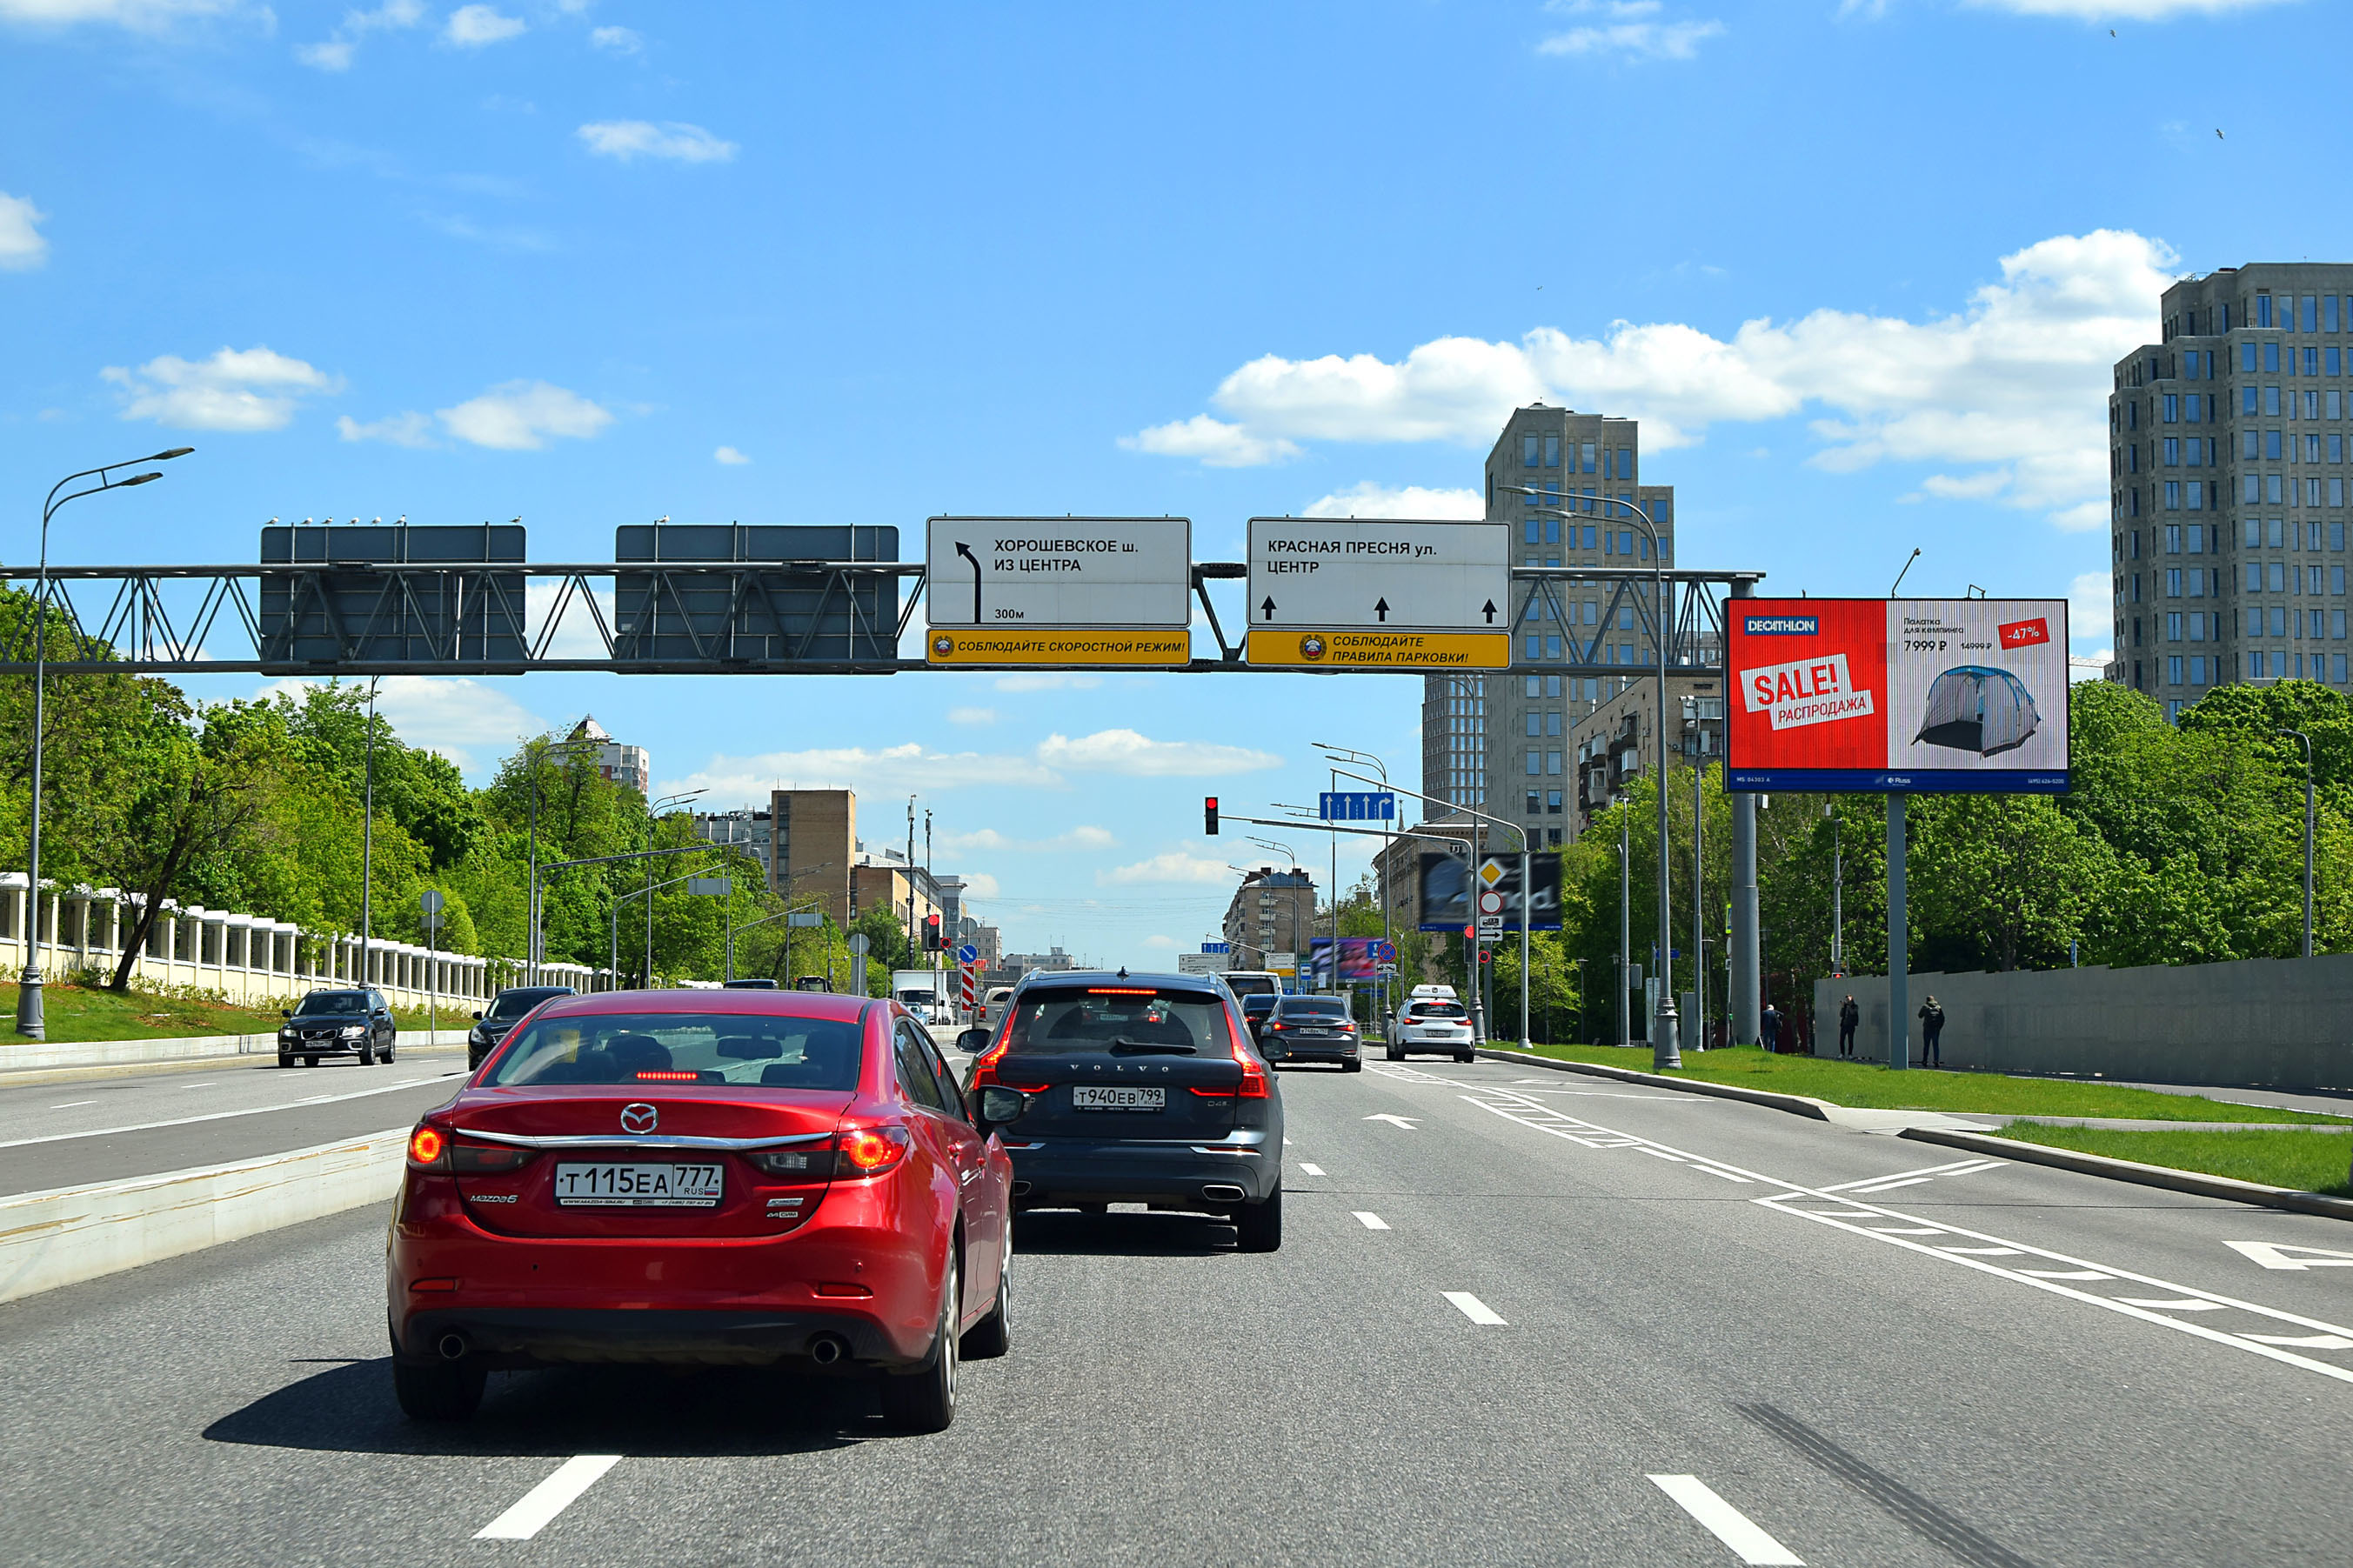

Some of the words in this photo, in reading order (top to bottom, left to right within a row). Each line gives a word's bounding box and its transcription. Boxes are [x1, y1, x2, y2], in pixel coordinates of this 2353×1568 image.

[994, 539, 1117, 552] ХОРОШЕВСКОЕ
[1122, 541, 1139, 552] ш.
[1267, 540, 1340, 553] КРАСНАЯ
[1346, 542, 1410, 554] ПРЕСНЯ
[1415, 544, 1437, 557] ул.
[994, 559, 1014, 571] ИЗ
[1019, 559, 1081, 573] ЦЕНТРА
[1267, 561, 1320, 574] ЦЕНТР
[994, 610, 1024, 619] 300м
[1748, 620, 1815, 632] DECATHLON
[1903, 617, 1941, 626] Палатка
[2007, 625, 2040, 640] -47%
[958, 639, 1046, 653] СОБЛЮДАЙТЕ
[1048, 639, 1132, 652] СКОРОСТНОЙ
[1135, 642, 1185, 652] РЕЖИМ!
[1333, 635, 1424, 648] СОБЛЮДАЙТЕ
[1332, 651, 1392, 663] ПРАВИЛА
[1394, 652, 1468, 664] ПАРКОВКИ!
[1754, 663, 1840, 706] SALE!
[1778, 697, 1868, 724] РАСПРОДАЖА
[1070, 1064, 1169, 1072] VOLVO
[1140, 1089, 1161, 1101] 799
[565, 1167, 668, 1193] Т115ЕА
[675, 1166, 716, 1187] 777
[684, 1187, 704, 1196] RUS
